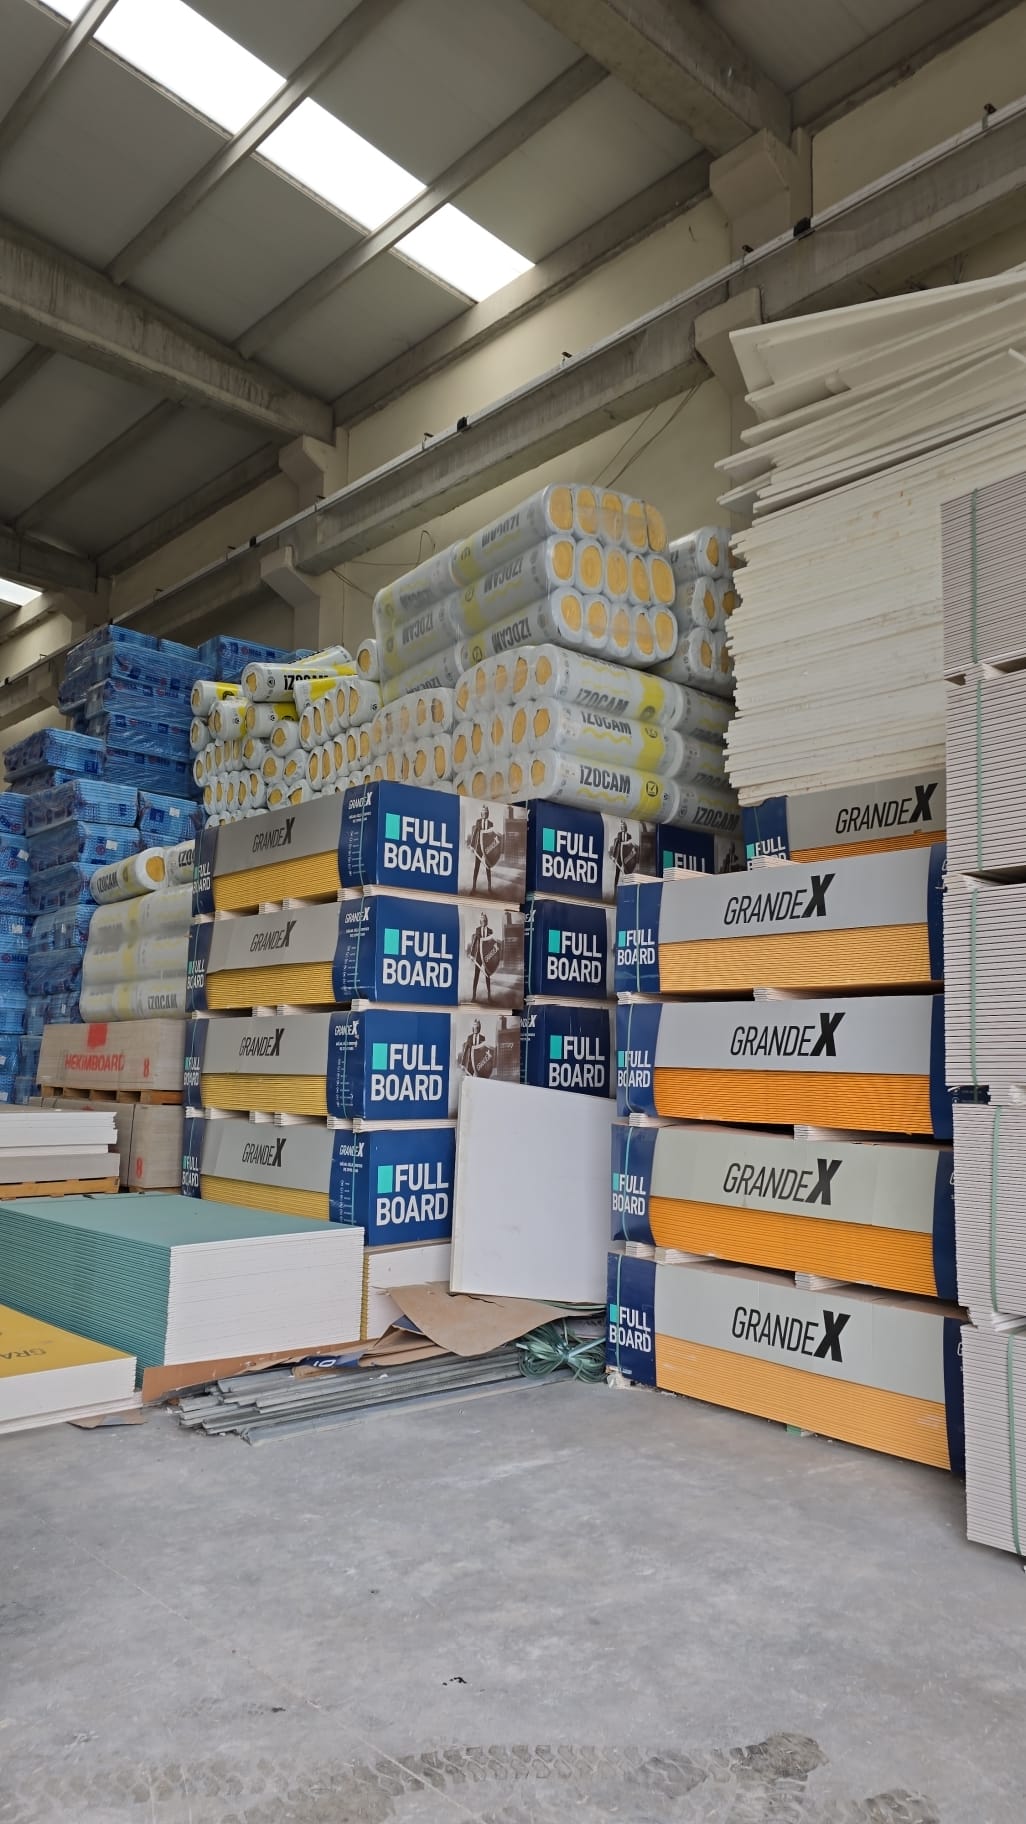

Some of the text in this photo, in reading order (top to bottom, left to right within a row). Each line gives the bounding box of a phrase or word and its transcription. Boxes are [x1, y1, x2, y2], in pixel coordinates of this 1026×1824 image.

[835, 783, 938, 834] GRANDEX
[252, 817, 295, 852] GRANDEX
[402, 816, 453, 848] FULL
[556, 830, 598, 859] FULL
[756, 836, 786, 857] FULL
[383, 842, 452, 877] BOARD
[542, 853, 598, 884] BOARD
[724, 873, 836, 925] GRANDEX
[250, 920, 296, 952] GRANDEX
[401, 929, 453, 959] FULL
[561, 929, 602, 958] FULL
[626, 929, 655, 946] FULL
[547, 956, 602, 983] BOARD
[617, 948, 655, 965] BOARD
[382, 958, 452, 988] BOARD
[239, 1028, 284, 1057] GRANDEX
[563, 1035, 606, 1061] FULL
[730, 1012, 846, 1057] GRANDEX
[389, 1044, 443, 1071] FULL
[625, 1051, 651, 1068] FULL
[370, 1074, 442, 1101] BOARD
[549, 1063, 605, 1088] BOARD
[617, 1069, 650, 1088] BOARD
[241, 1138, 286, 1167] GRANDEX
[136, 1157, 143, 1178] 8
[395, 1162, 449, 1192] FULL
[723, 1158, 843, 1205] GRANDEX
[620, 1174, 646, 1195] FULL
[376, 1192, 449, 1226] BOARD
[612, 1194, 645, 1216] BOARD
[620, 1306, 651, 1332] FULL
[609, 1324, 651, 1353] BOARD
[731, 1306, 851, 1363] GRANDEX
